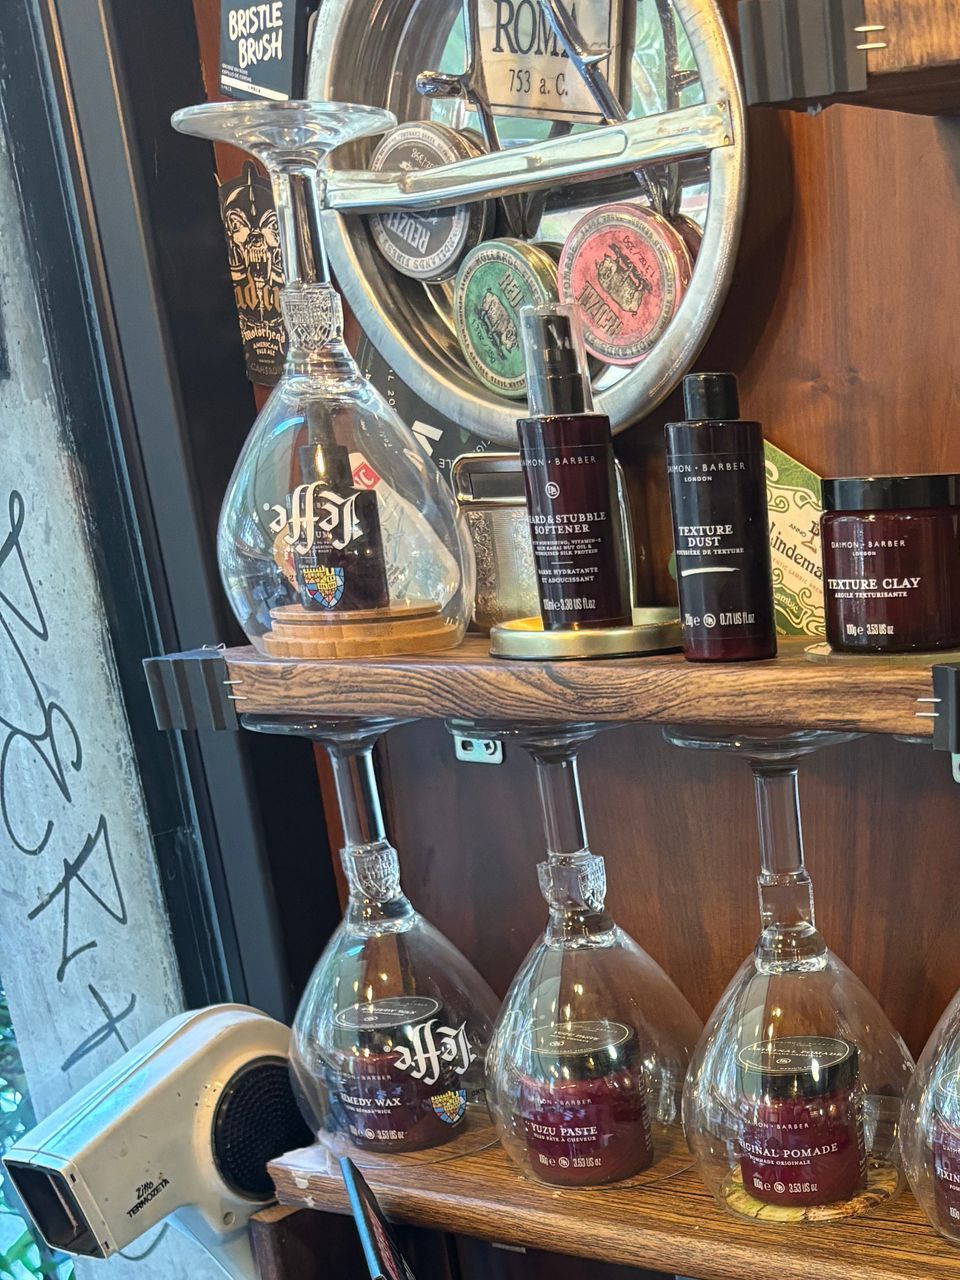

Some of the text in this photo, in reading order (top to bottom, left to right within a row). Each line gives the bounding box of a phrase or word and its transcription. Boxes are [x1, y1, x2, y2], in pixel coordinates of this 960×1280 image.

[229, 1, 283, 41] BRISTLE
[238, 28, 283, 69] BRUSH
[509, 69, 568, 96] 753 a. C.
[554, 456, 597, 467] BARBER
[702, 463, 746, 473] BARBER
[555, 511, 607, 524] STUBBLE
[534, 524, 590, 535] SOFTENER
[678, 525, 734, 537] TEXTURE
[788, 523, 808, 539] ANNO
[688, 537, 722, 548] DUST
[831, 540, 906, 549] DAIMON BARBER
[713, 548, 745, 556] TEXTURE
[553, 567, 599, 575] HYDRATANTE
[827, 577, 921, 590] TEXTURE CLAY
[374, 1096, 402, 1107] WAX
[530, 1122, 598, 1137] YUZU PASTE
[776, 1122, 810, 1131] BARBER
[783, 1142, 839, 1159] POMADE
[573, 1157, 587, 1169] 3.53
[788, 1182, 802, 1194] 3.53
